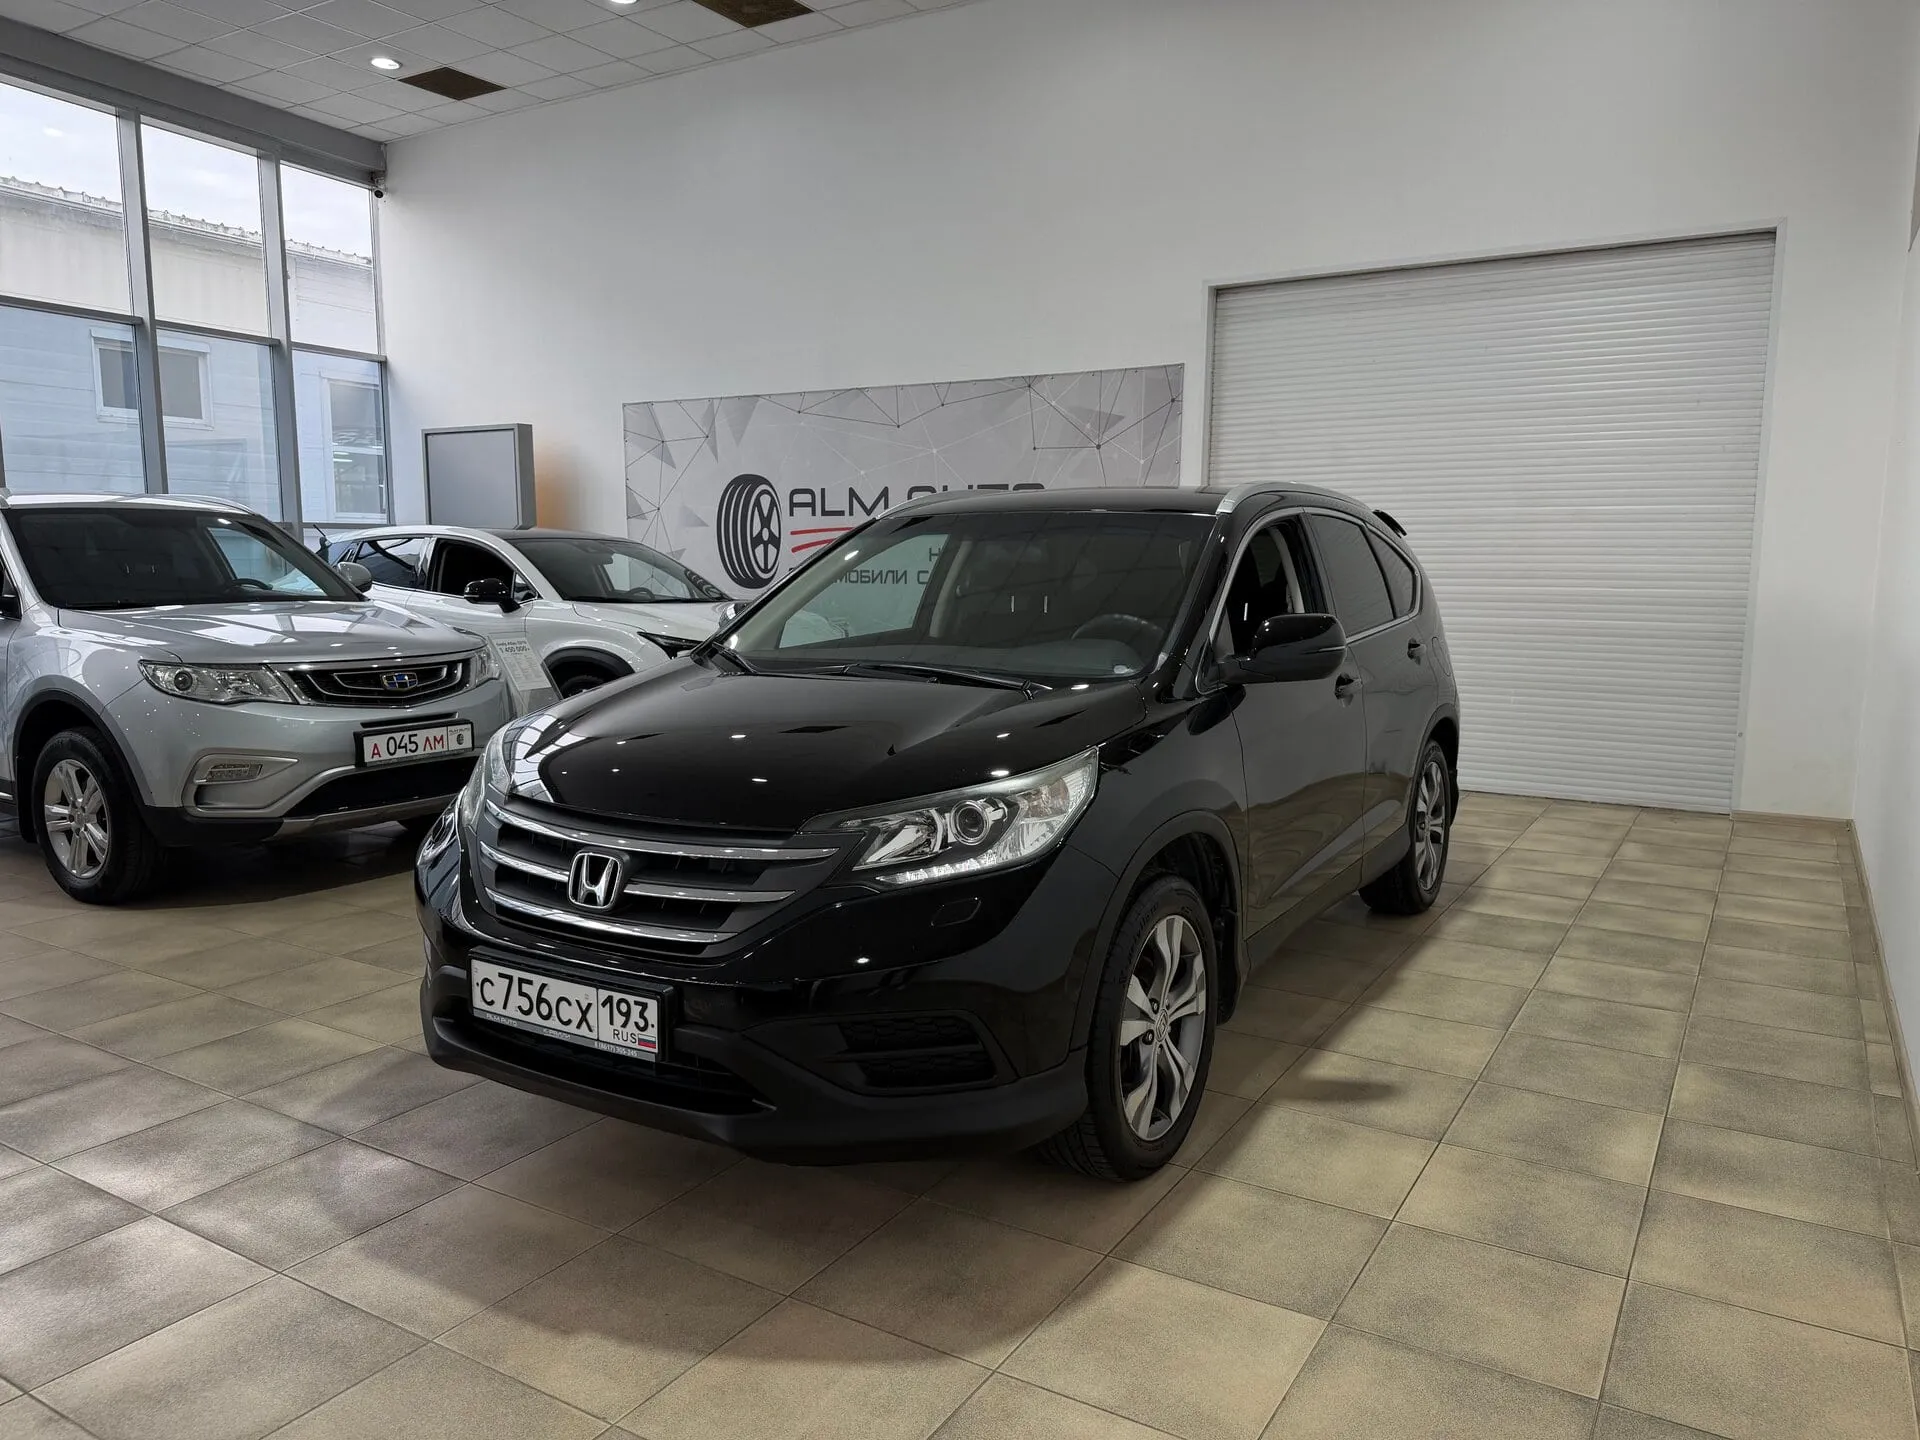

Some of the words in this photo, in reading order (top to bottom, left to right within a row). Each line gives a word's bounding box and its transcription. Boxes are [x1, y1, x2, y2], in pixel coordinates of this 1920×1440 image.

[789, 486, 890, 517] ALM
[386, 733, 419, 757] 045
[600, 994, 650, 1033] 193
[612, 1028, 637, 1044] RUS
